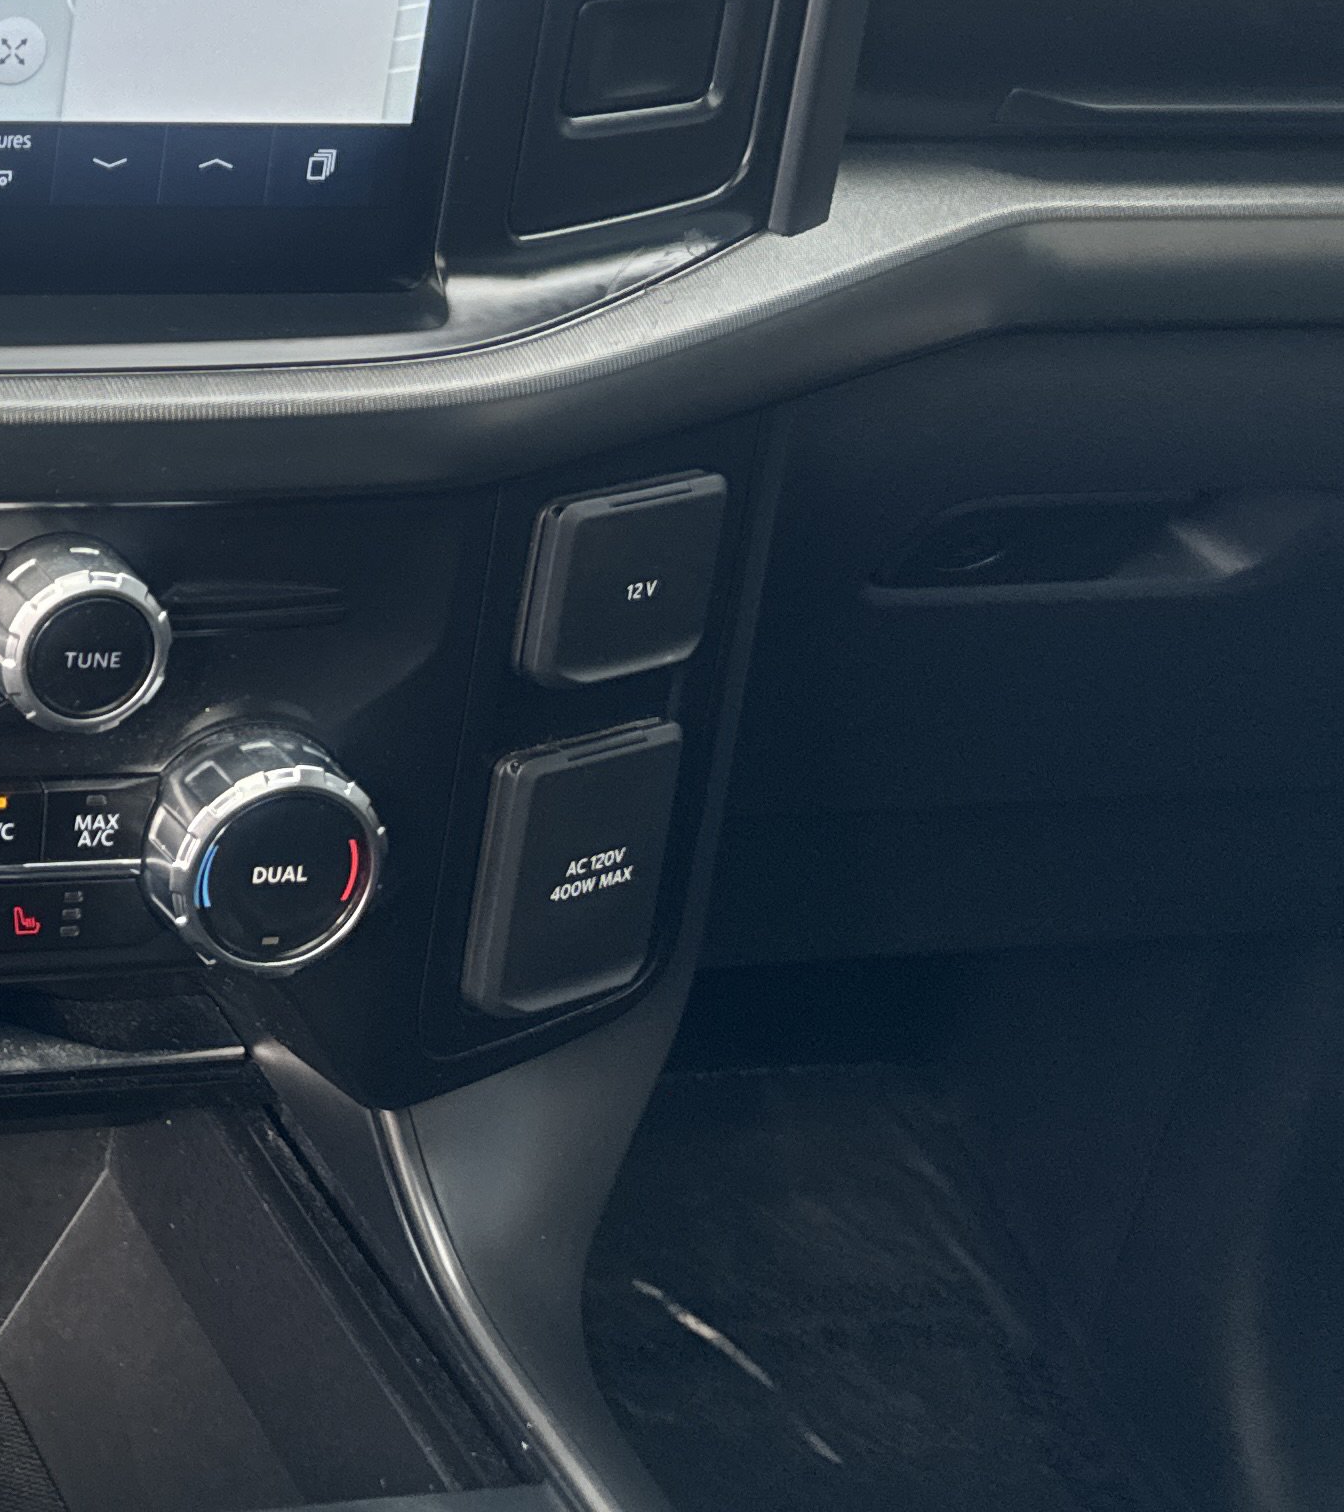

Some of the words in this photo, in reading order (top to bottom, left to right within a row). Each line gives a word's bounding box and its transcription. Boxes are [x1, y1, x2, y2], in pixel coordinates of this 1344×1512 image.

[64, 650, 123, 671] TUNE
[73, 813, 120, 832] MAX
[77, 828, 115, 848] A/C
[566, 857, 589, 878] AC
[591, 846, 627, 870] 120V
[251, 864, 308, 885] DUAL
[550, 877, 596, 902] 400W
[598, 865, 634, 889] MAX
